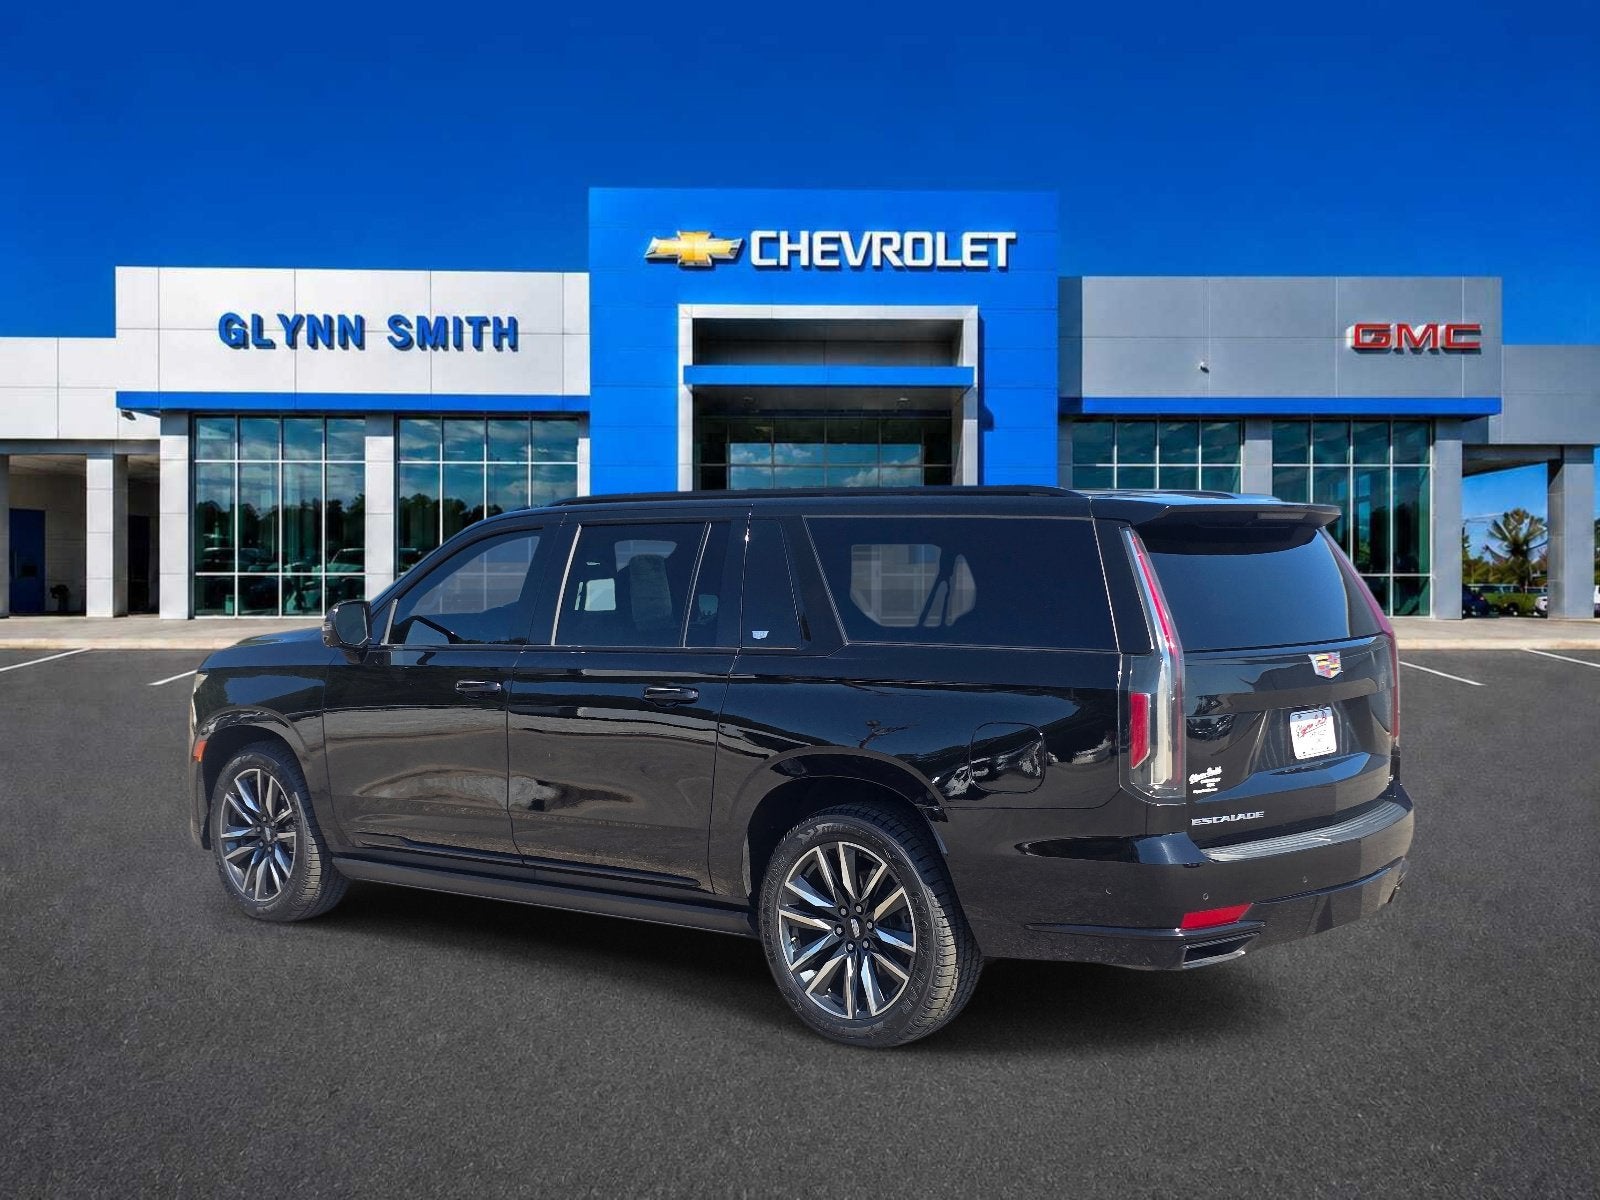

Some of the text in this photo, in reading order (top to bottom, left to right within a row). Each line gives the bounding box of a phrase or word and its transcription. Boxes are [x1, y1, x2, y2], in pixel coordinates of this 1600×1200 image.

[750, 230, 1017, 268] CHEVROLET
[218, 312, 519, 352] GLYNN SMITH
[1352, 322, 1482, 352] GMC
[1191, 811, 1265, 826] ESCALADE
